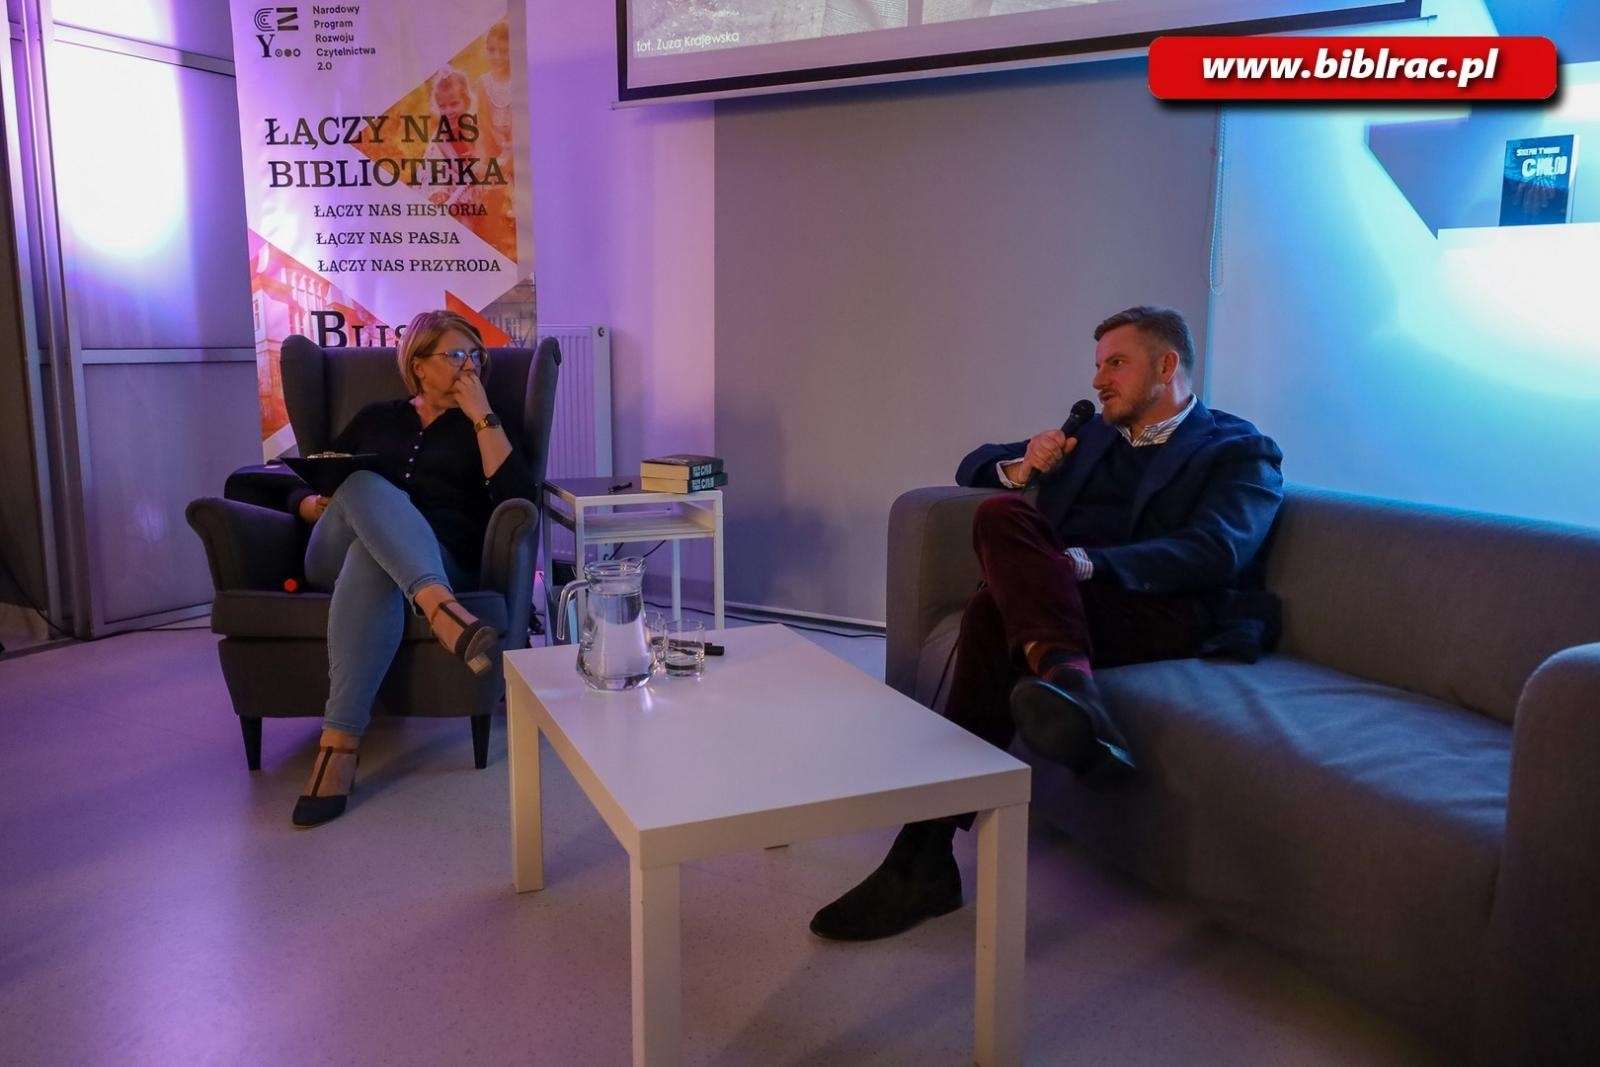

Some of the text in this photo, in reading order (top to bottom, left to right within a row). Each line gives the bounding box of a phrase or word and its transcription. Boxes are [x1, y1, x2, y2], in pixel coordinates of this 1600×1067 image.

[312, 5, 360, 15] Narodowy
[314, 19, 353, 30] Program
[315, 33, 354, 43] Rozwoju
[657, 38, 682, 51] Zuza
[684, 31, 740, 48] Krajewska
[316, 47, 376, 58] Czytelnictwa
[317, 62, 333, 71] 2.0
[264, 113, 480, 150] ŁĄCZY NAS
[268, 157, 509, 188] BIBLIOTEKA
[313, 203, 488, 219] ŁĄCZY NAS HISTORIA
[315, 231, 460, 247] ŁĄCZY NAS PASJA
[317, 258, 501, 275] ŁĄCZY NAS PRZYRODA
